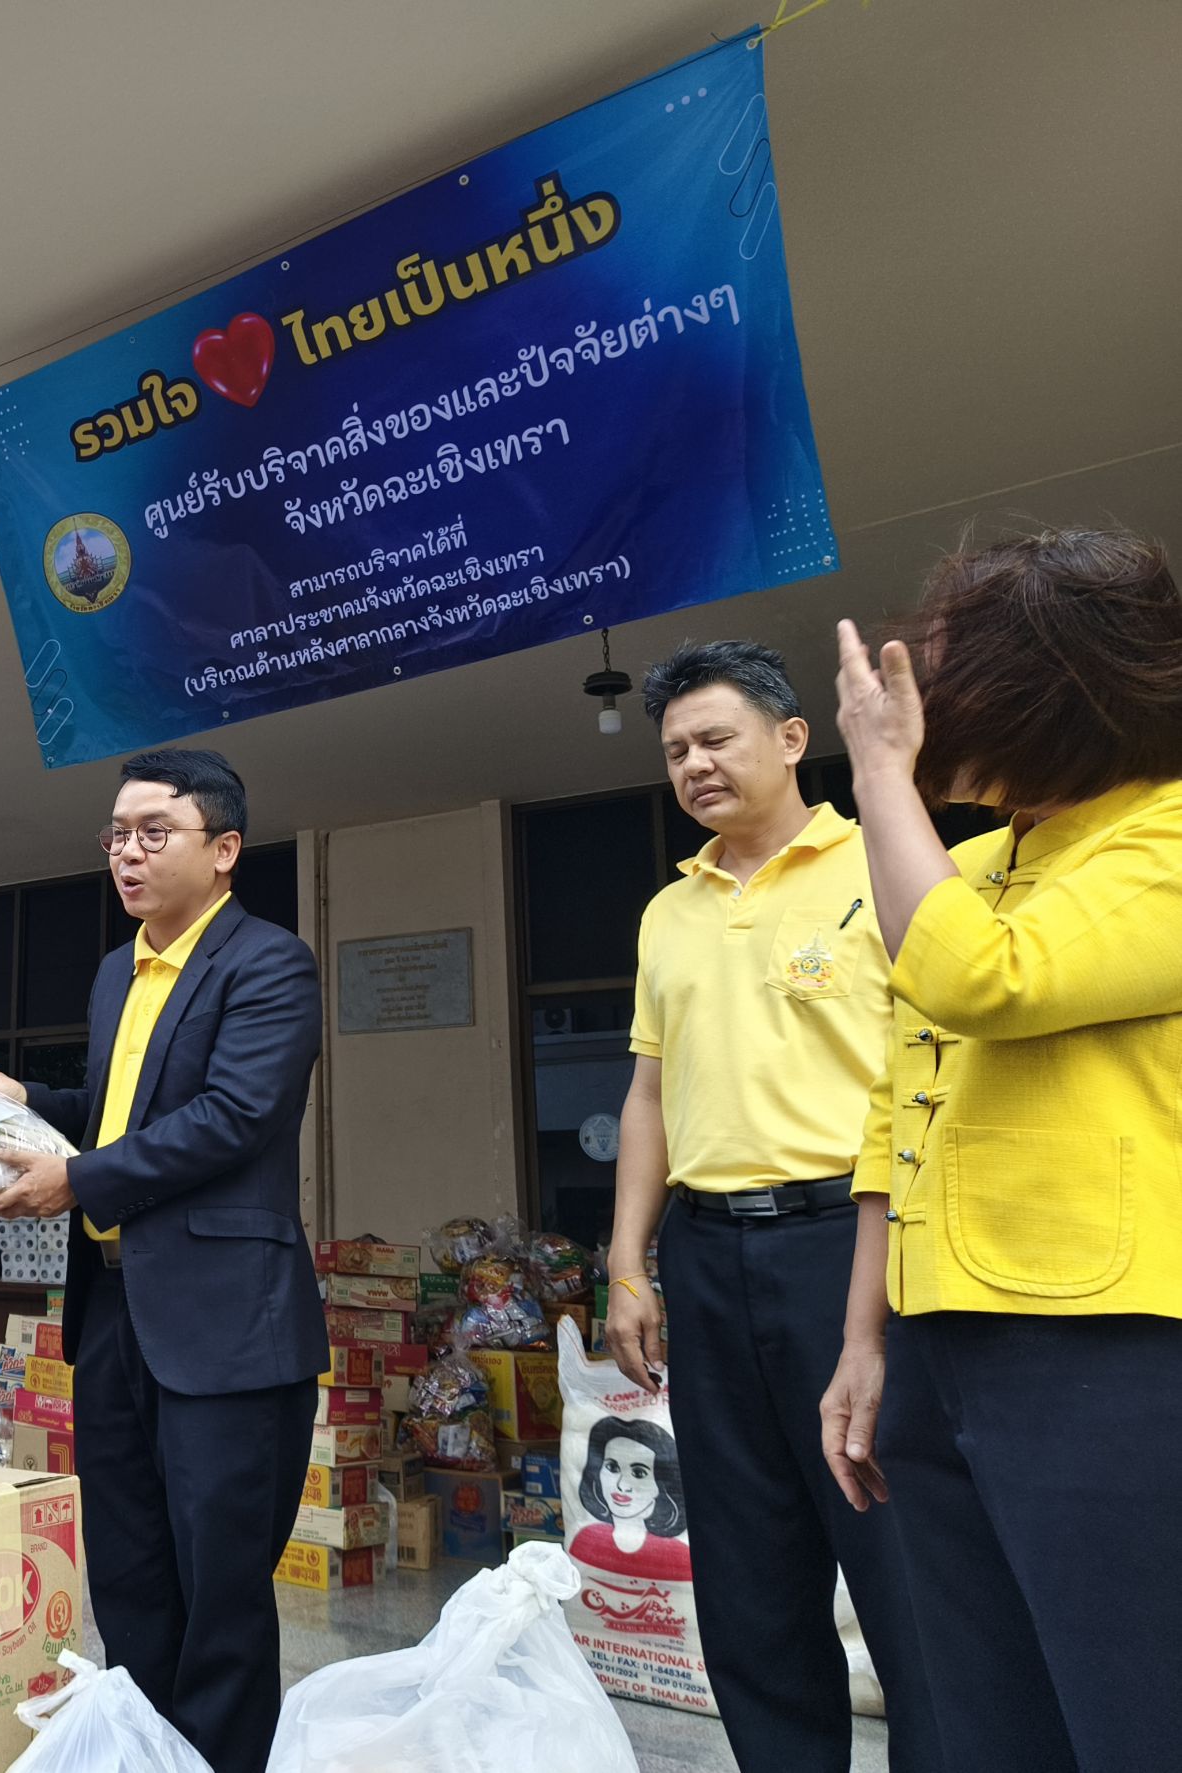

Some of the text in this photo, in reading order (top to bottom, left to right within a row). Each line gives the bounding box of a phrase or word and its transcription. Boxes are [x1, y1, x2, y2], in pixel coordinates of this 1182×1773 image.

[74, 181, 617, 457] รวมใจ ไทยเป็นหนึ่ง
[144, 283, 741, 539] ศูนย์รับบริจาคสิ่งของและปัจจัยต่างๆ
[284, 416, 571, 536] จังหวัดฉะเชิงเทรา
[229, 545, 545, 650] ศาลาประชาคมจังหวัดฉะเชิงเทรา
[289, 513, 470, 598] สามารถบริจาคได้ที่
[184, 555, 631, 697] (บริเวณด้านหลังศาลากลางจังหวัดฉะเชิงเทรา)
[573, 1633, 590, 1647] AR
[593, 1638, 694, 1670] INTERNATIONAL
[591, 1650, 609, 1661] TEL
[618, 1656, 640, 1668] FAX:
[605, 1665, 639, 1679] 01/2024
[651, 1676, 670, 1687] EXP
[632, 1683, 647, 1693] OF
[650, 1686, 708, 1708] THAILAND
